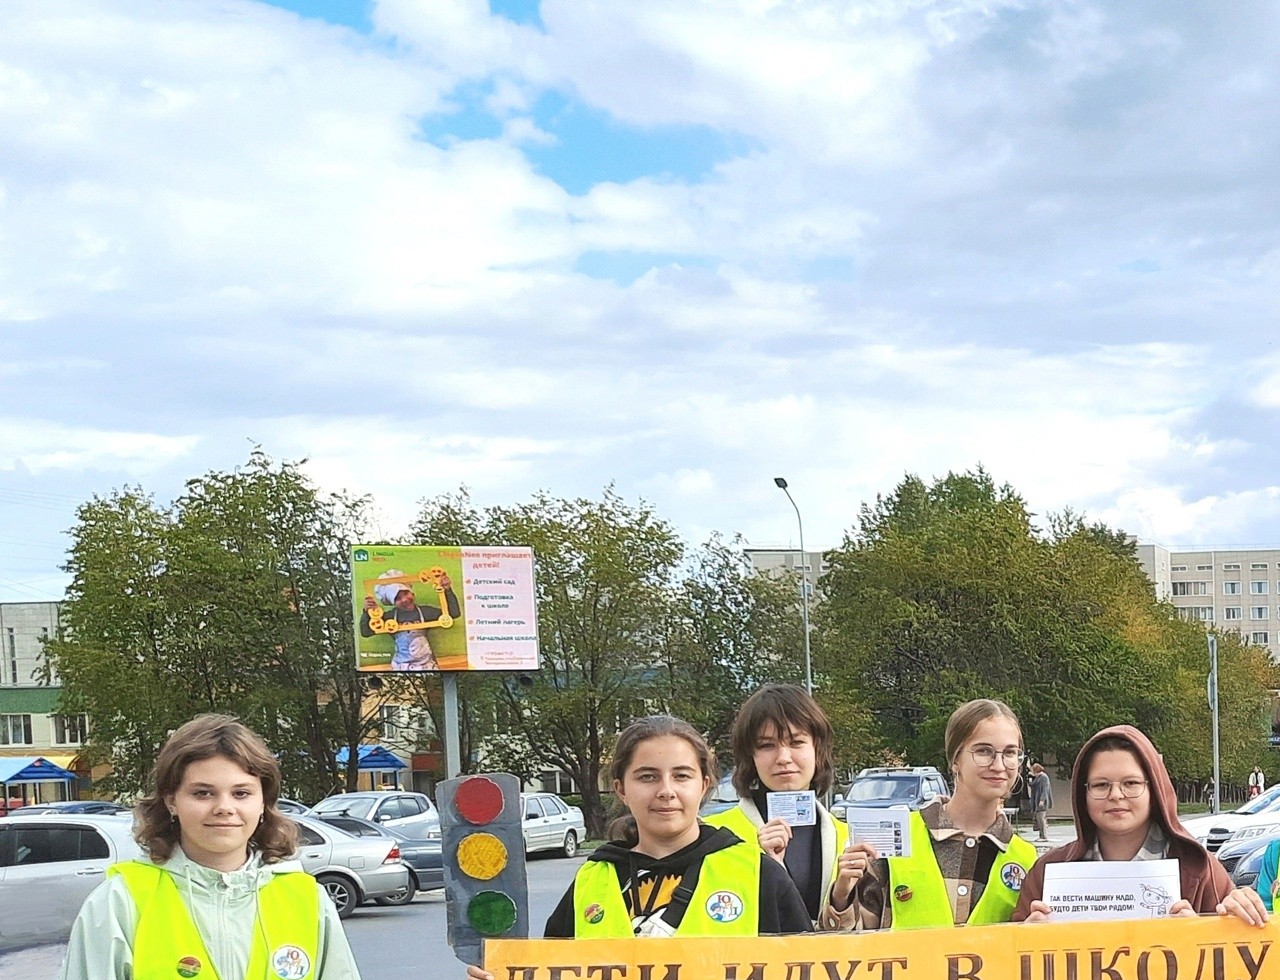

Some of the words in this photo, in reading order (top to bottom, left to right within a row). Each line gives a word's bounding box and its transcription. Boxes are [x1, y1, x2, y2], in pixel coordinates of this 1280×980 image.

[355, 553, 368, 561] LN
[472, 562, 500, 570] детей!
[473, 578, 502, 586] Детский
[1062, 894, 1083, 902] ВЕСТИ
[1084, 894, 1114, 902] МАШИНУ
[1049, 905, 1070, 913] БУДТО
[1071, 905, 1089, 913] ДЕТИ
[1090, 904, 1107, 912] ТВОИ
